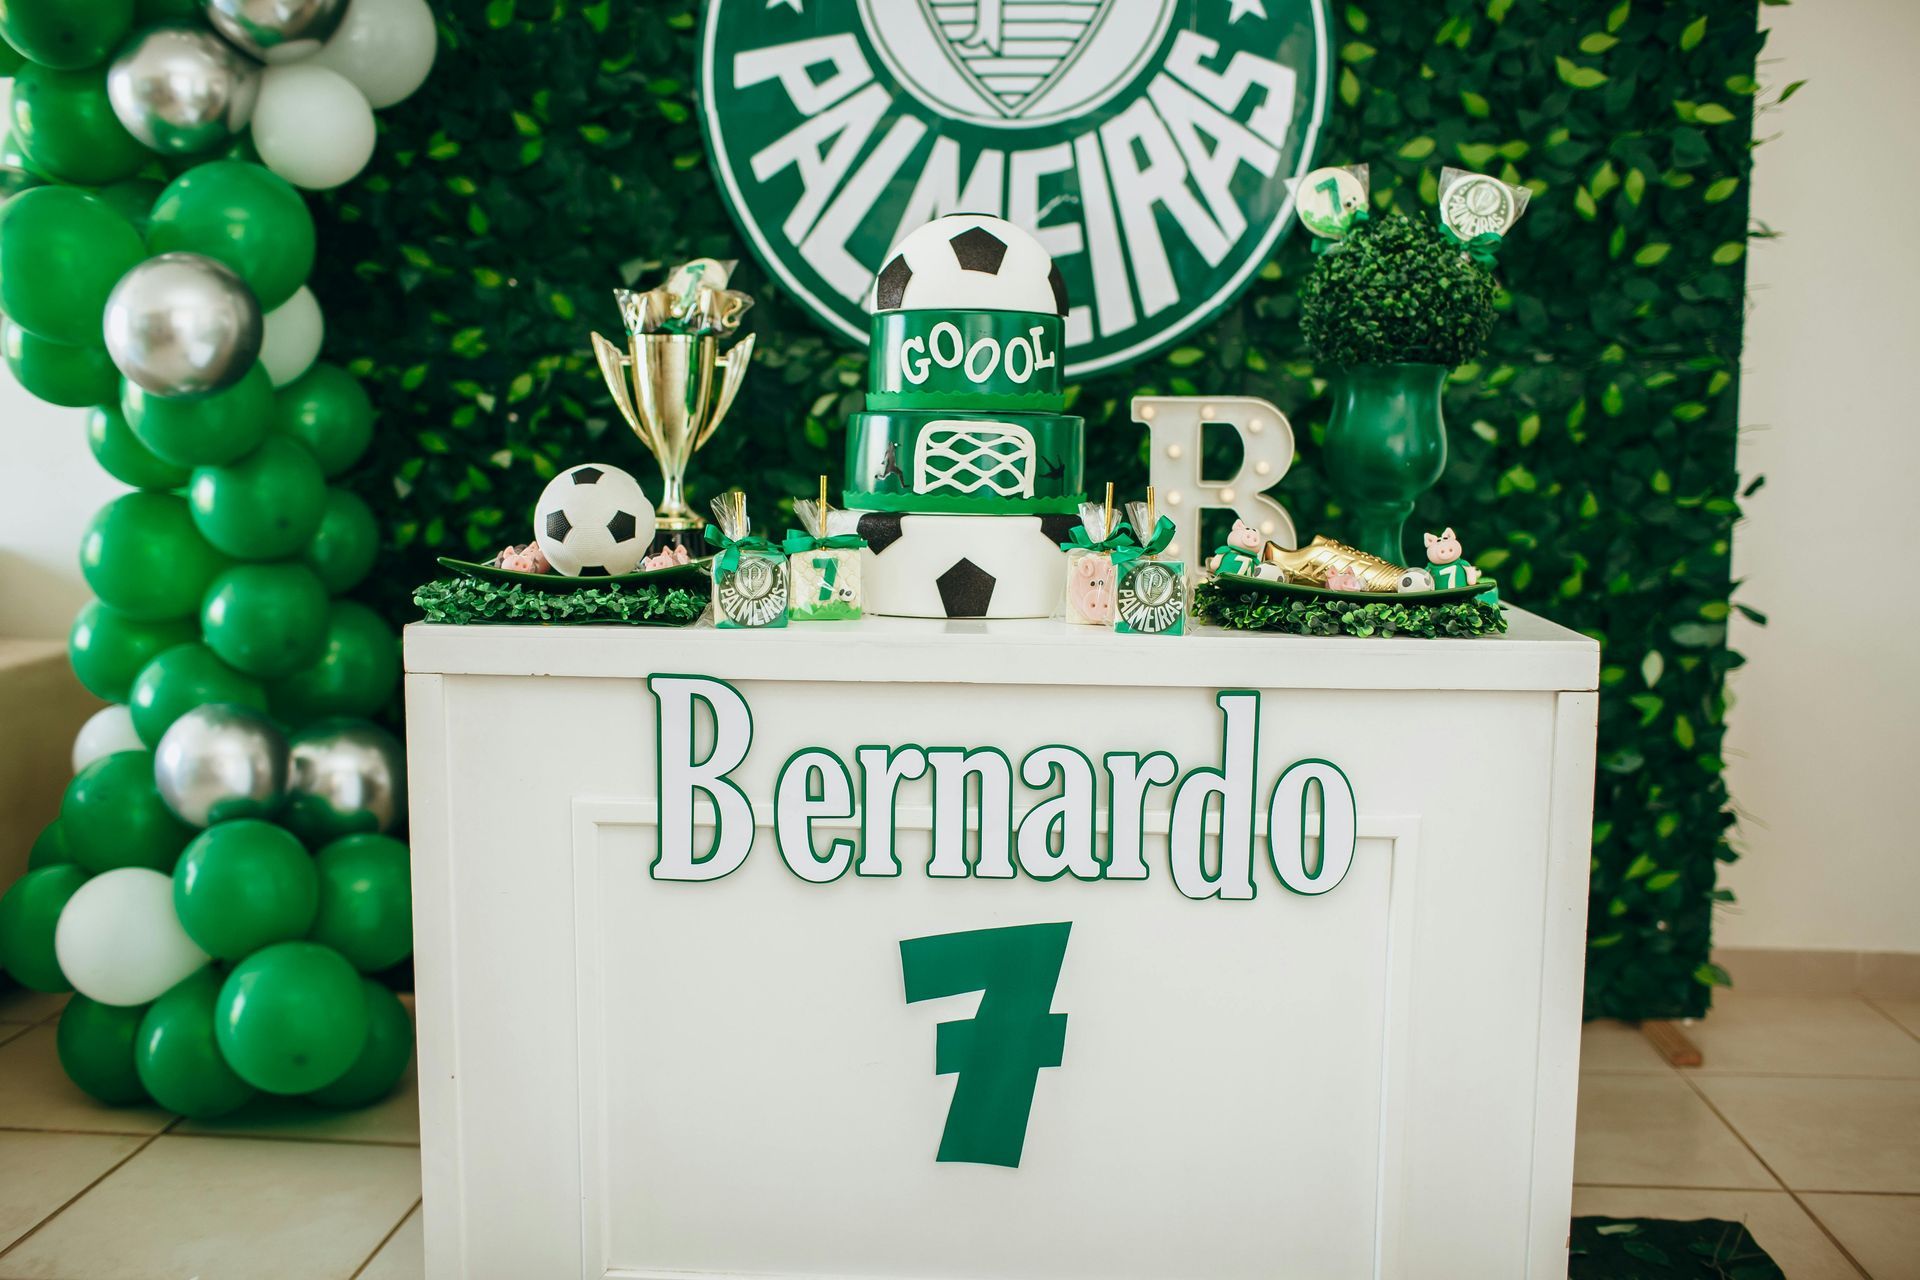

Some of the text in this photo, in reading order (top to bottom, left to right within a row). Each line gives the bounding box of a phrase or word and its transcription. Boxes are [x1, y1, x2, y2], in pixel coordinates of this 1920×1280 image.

[1315, 176, 1342, 214] 7
[900, 321, 1055, 384] GOOOL
[1131, 396, 1297, 582] B
[812, 557, 839, 600] 7
[1439, 565, 1456, 589] 7
[720, 587, 787, 625] PALMEIRAS
[1118, 589, 1183, 633] PALMEIRAS
[646, 672, 1357, 900] Bernardo
[899, 921, 1073, 1168] 7
